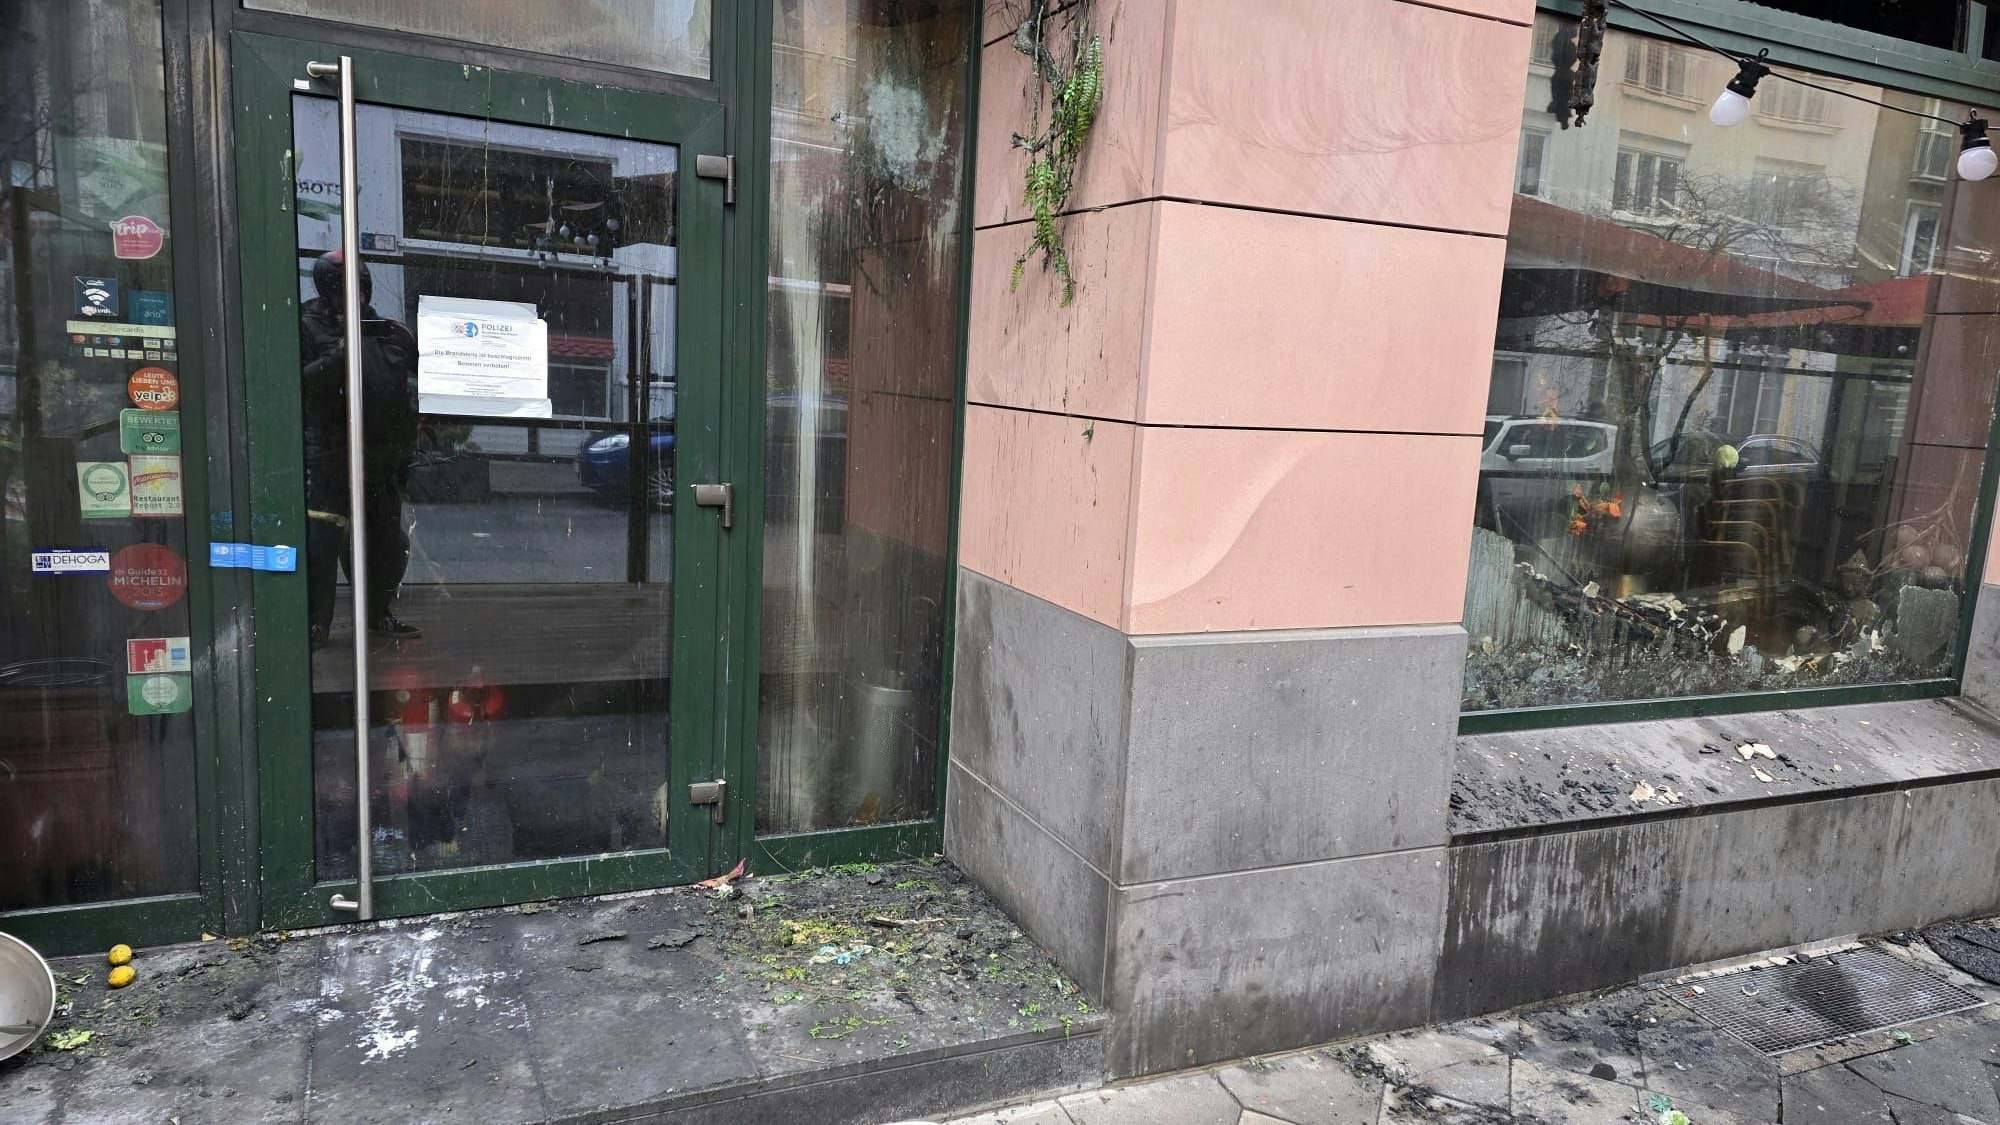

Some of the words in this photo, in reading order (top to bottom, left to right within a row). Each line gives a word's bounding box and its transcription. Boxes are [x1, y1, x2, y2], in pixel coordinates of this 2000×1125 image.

[481, 323, 513, 332] POLIZEI
[132, 376, 158, 385] LIEBEN
[135, 390, 162, 401] yelp
[53, 555, 106, 565] DEHOGA
[127, 568, 157, 576] Guide
